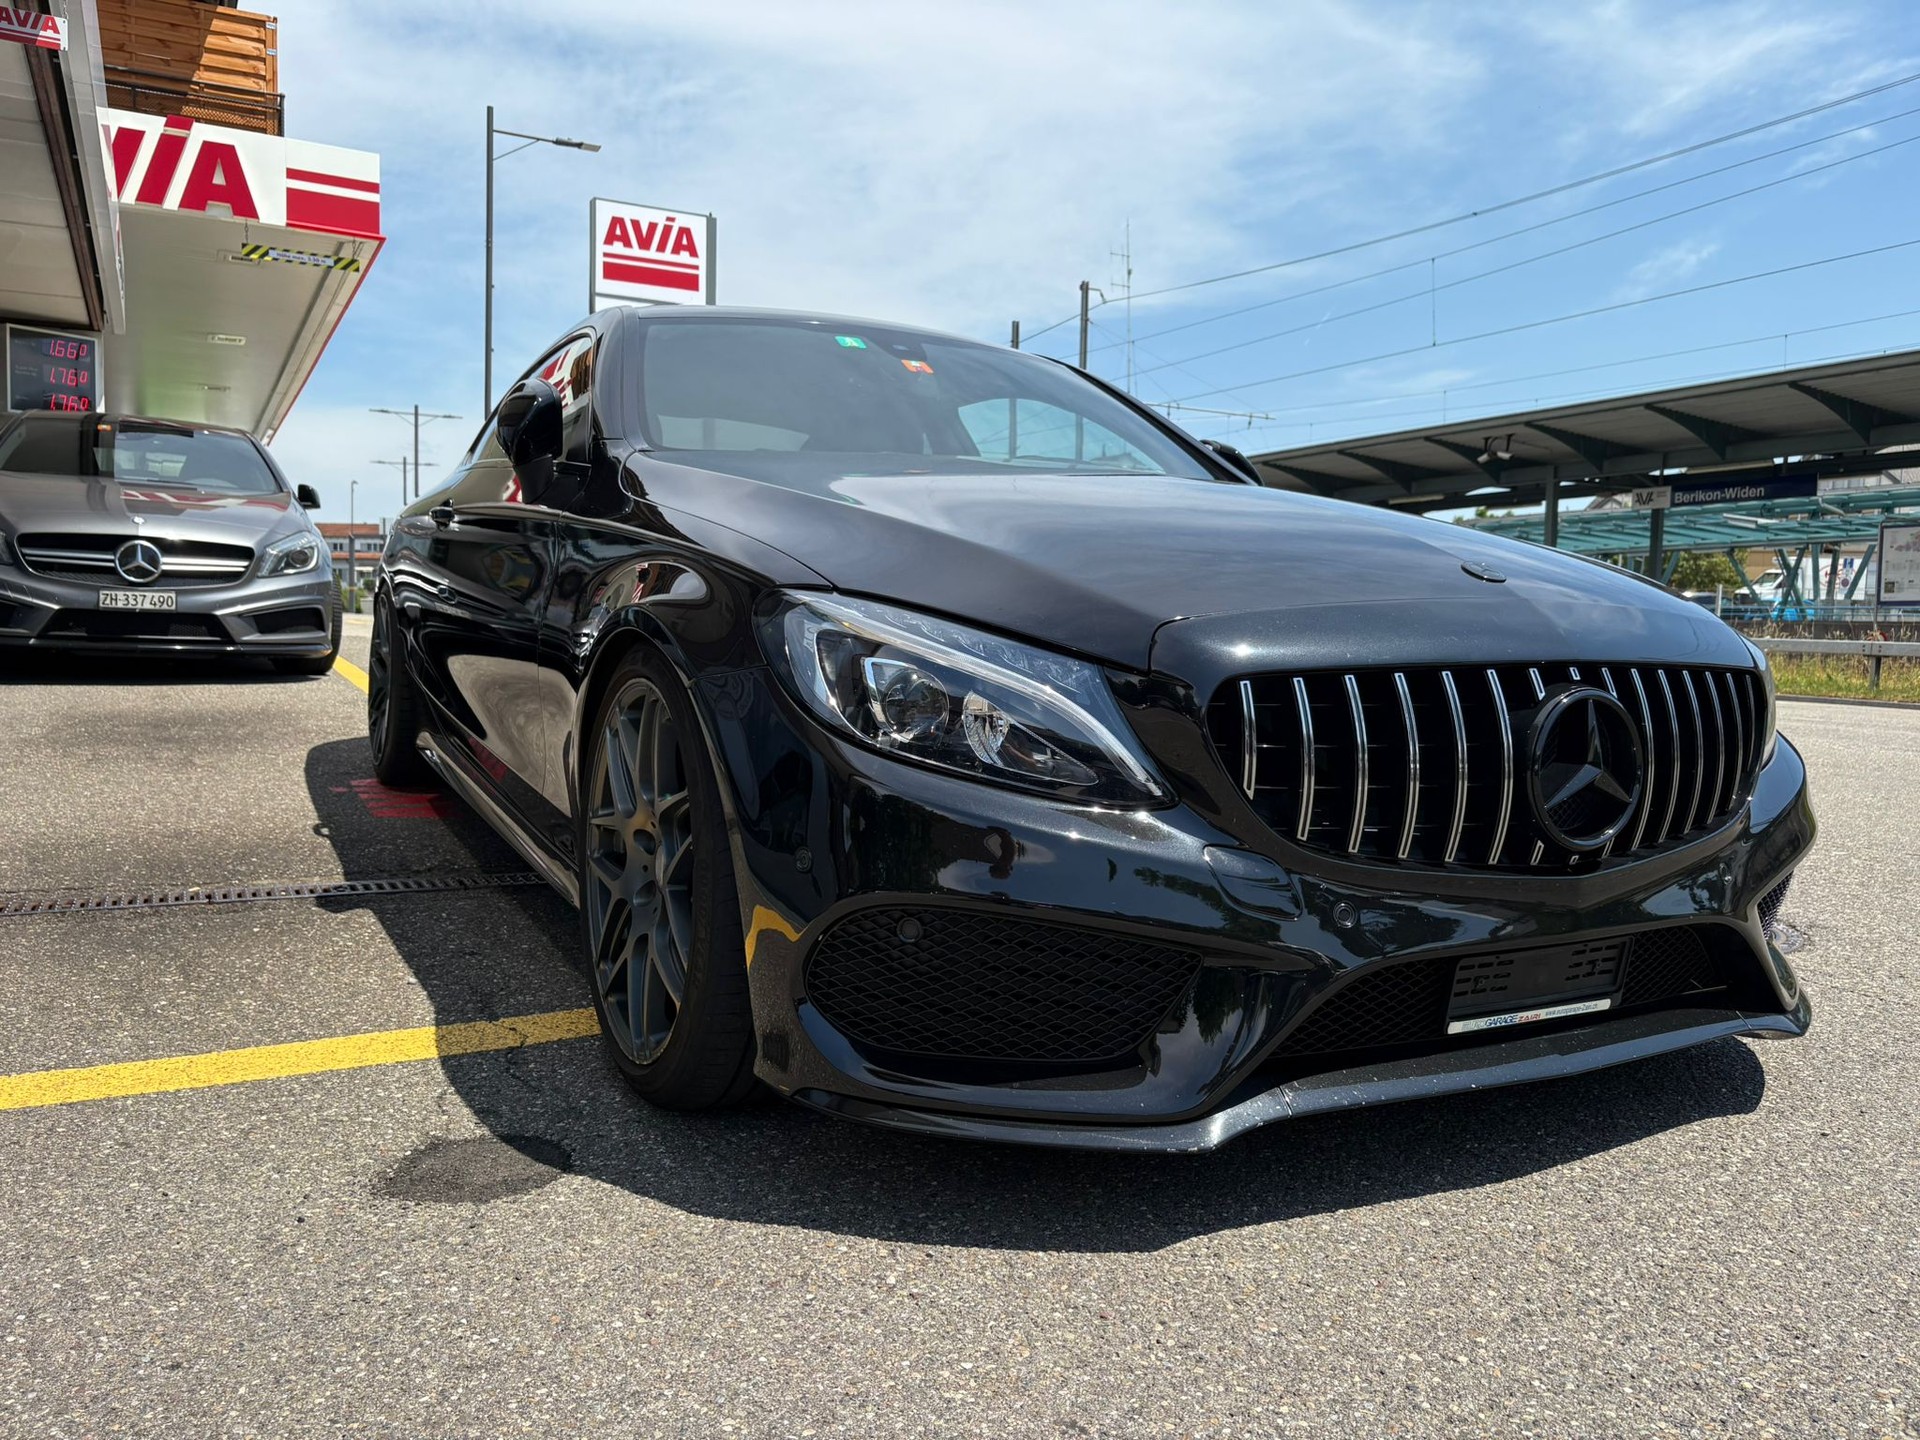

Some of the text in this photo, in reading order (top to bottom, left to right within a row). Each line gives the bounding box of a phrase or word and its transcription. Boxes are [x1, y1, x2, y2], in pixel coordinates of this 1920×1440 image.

[101, 114, 260, 220] VIA
[603, 216, 699, 259] AVIA
[1674, 486, 1765, 504] Berikon-Widen
[1517, 1013, 1542, 1023] ZAIRI
